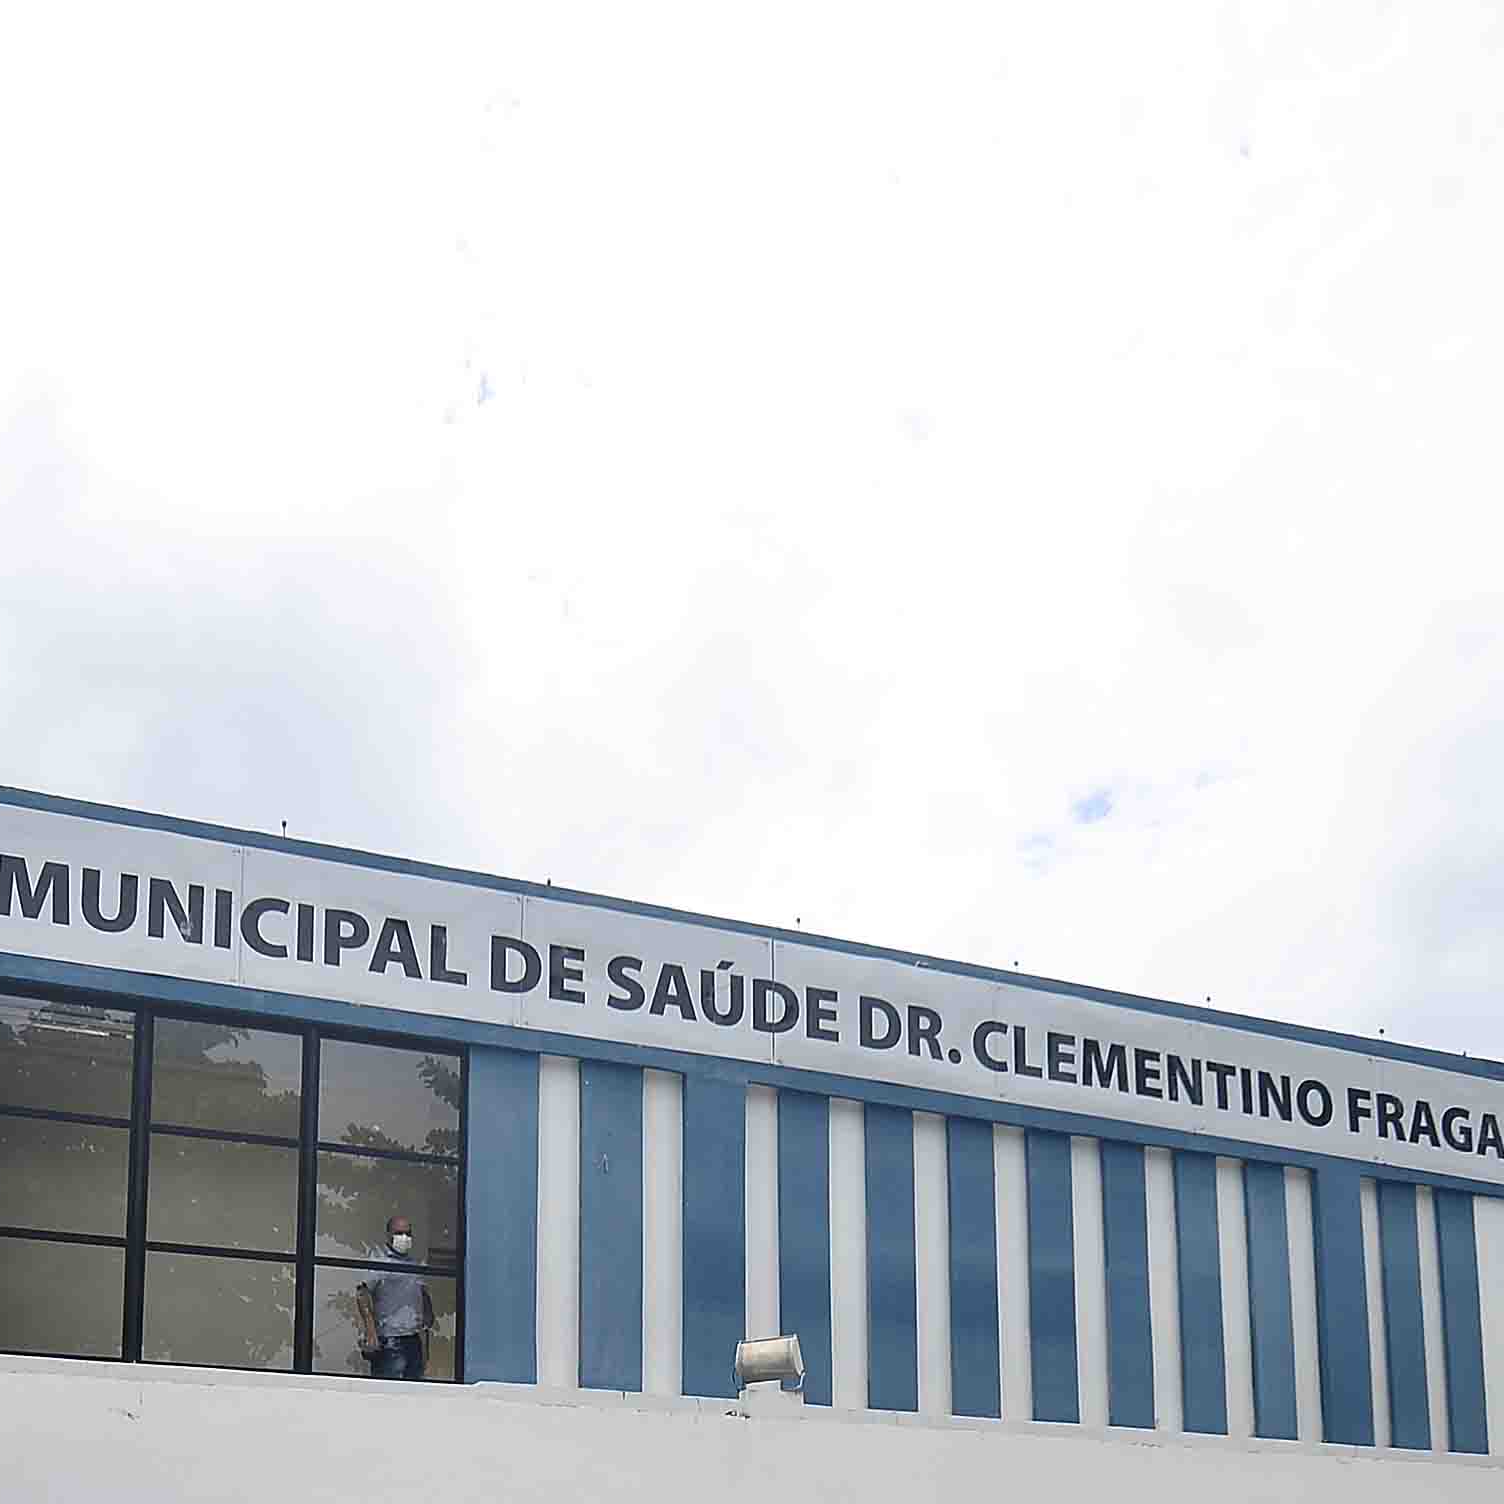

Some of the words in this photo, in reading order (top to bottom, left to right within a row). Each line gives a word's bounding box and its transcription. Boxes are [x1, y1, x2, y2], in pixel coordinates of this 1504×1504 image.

[490, 935, 586, 1004] DE
[606, 956, 841, 1043] SAÚDE
[859, 995, 962, 1063] DR.
[973, 1021, 1334, 1126] CLEMENTINO
